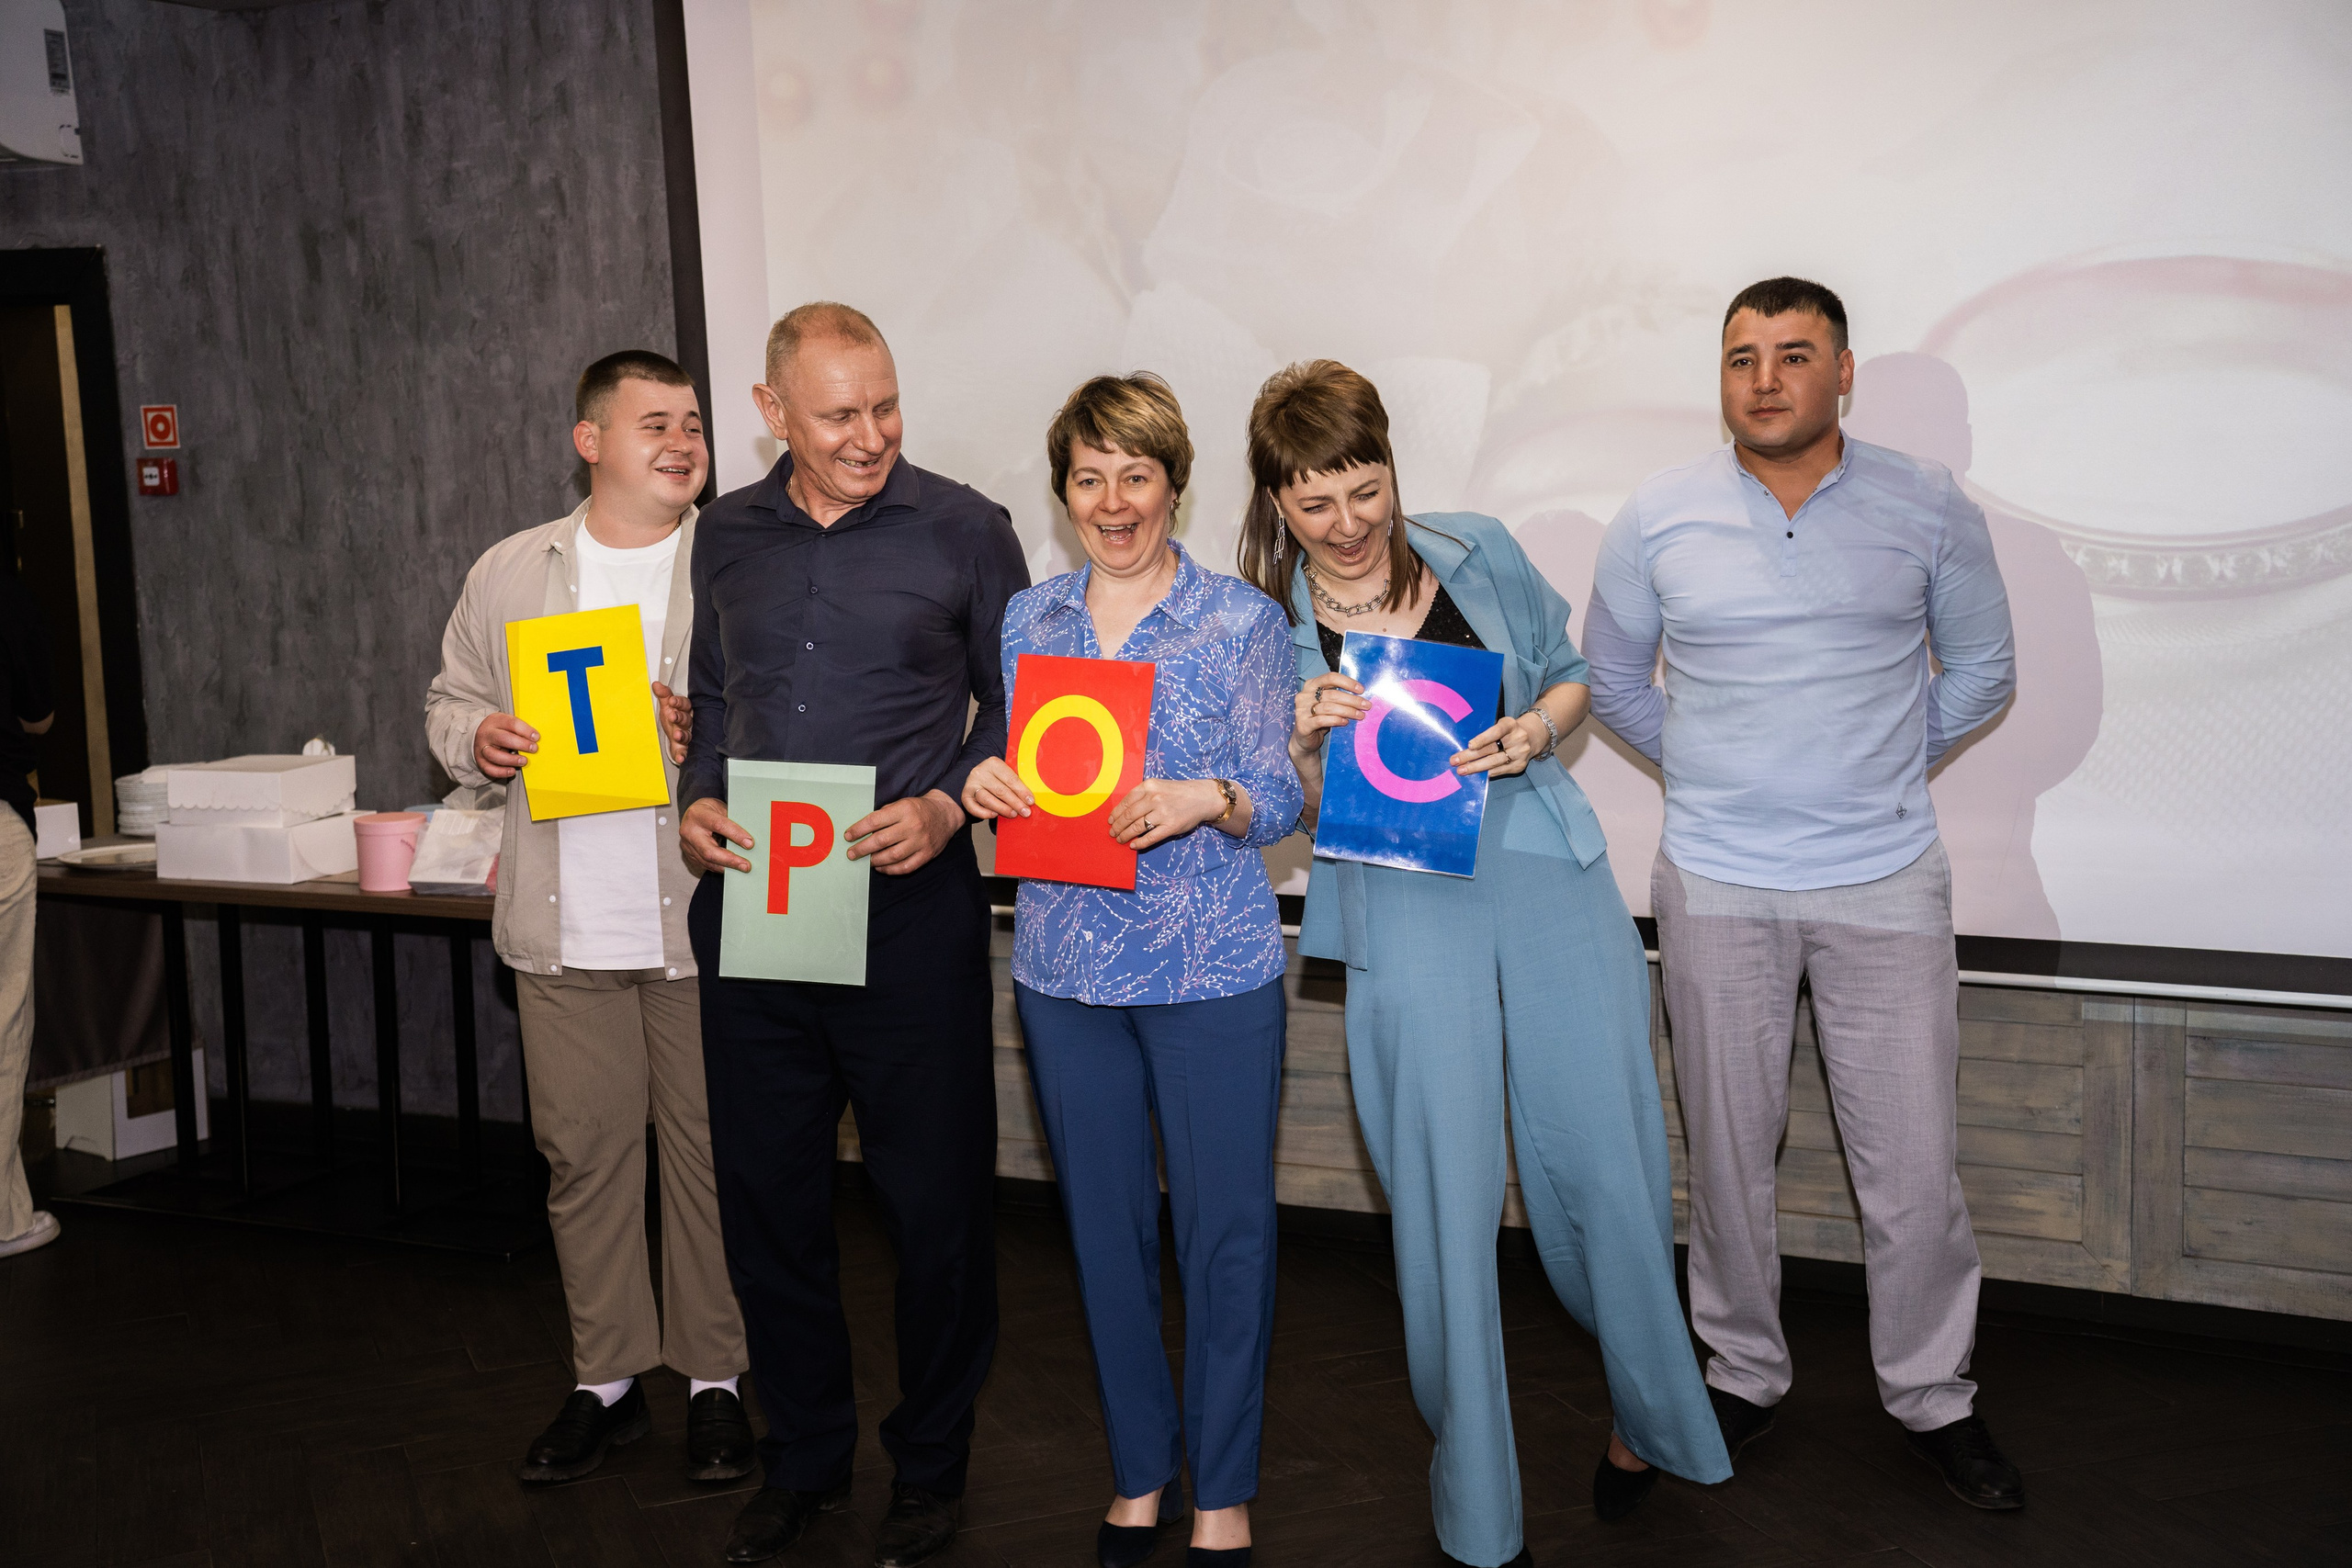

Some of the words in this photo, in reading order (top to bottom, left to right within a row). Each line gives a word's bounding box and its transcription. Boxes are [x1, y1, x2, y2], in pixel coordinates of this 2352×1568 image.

[548, 646, 605, 755] Т
[1017, 694, 1125, 818] О
[1354, 678, 1475, 804] С
[767, 800, 835, 915] Р
